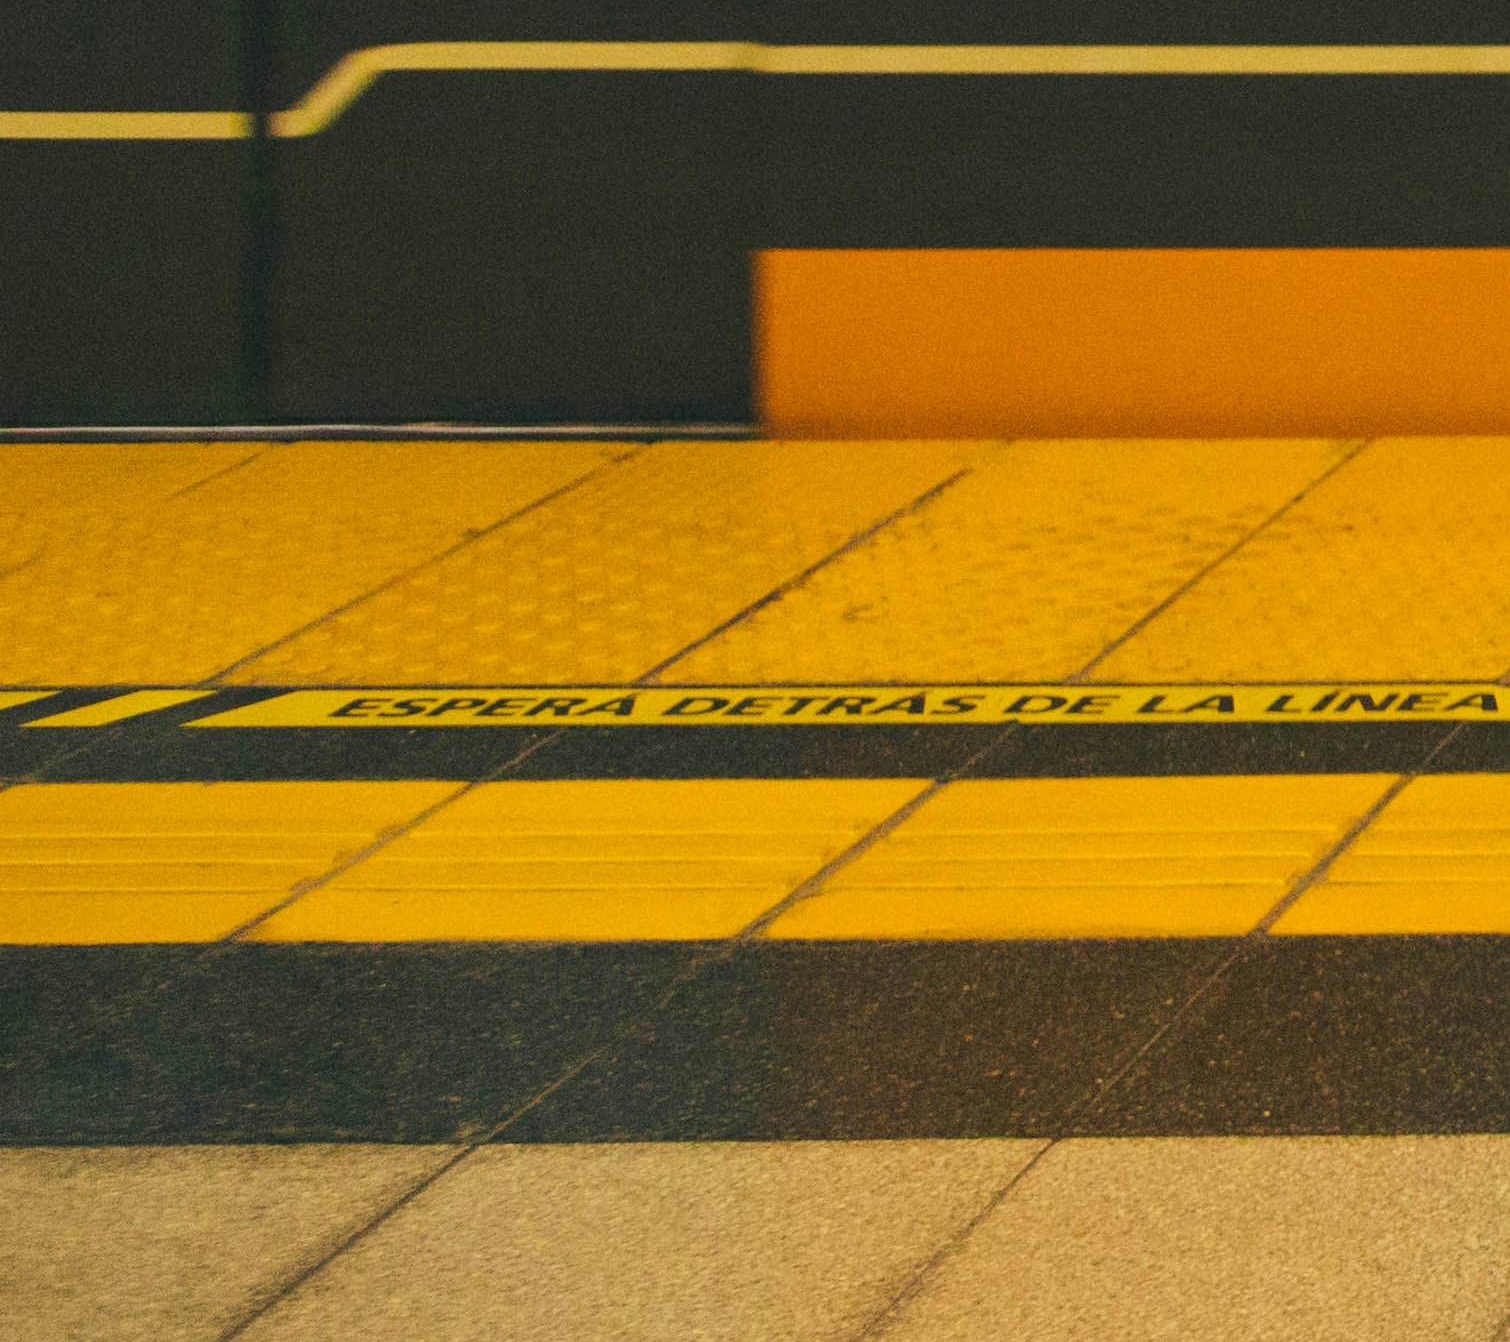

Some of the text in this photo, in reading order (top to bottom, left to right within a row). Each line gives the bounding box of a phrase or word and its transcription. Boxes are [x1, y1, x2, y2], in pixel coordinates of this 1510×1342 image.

[658, 690, 988, 717] DETRÁS
[1002, 693, 1120, 716] DE
[1135, 693, 1237, 715] LA
[1264, 687, 1502, 715] LÍNEA
